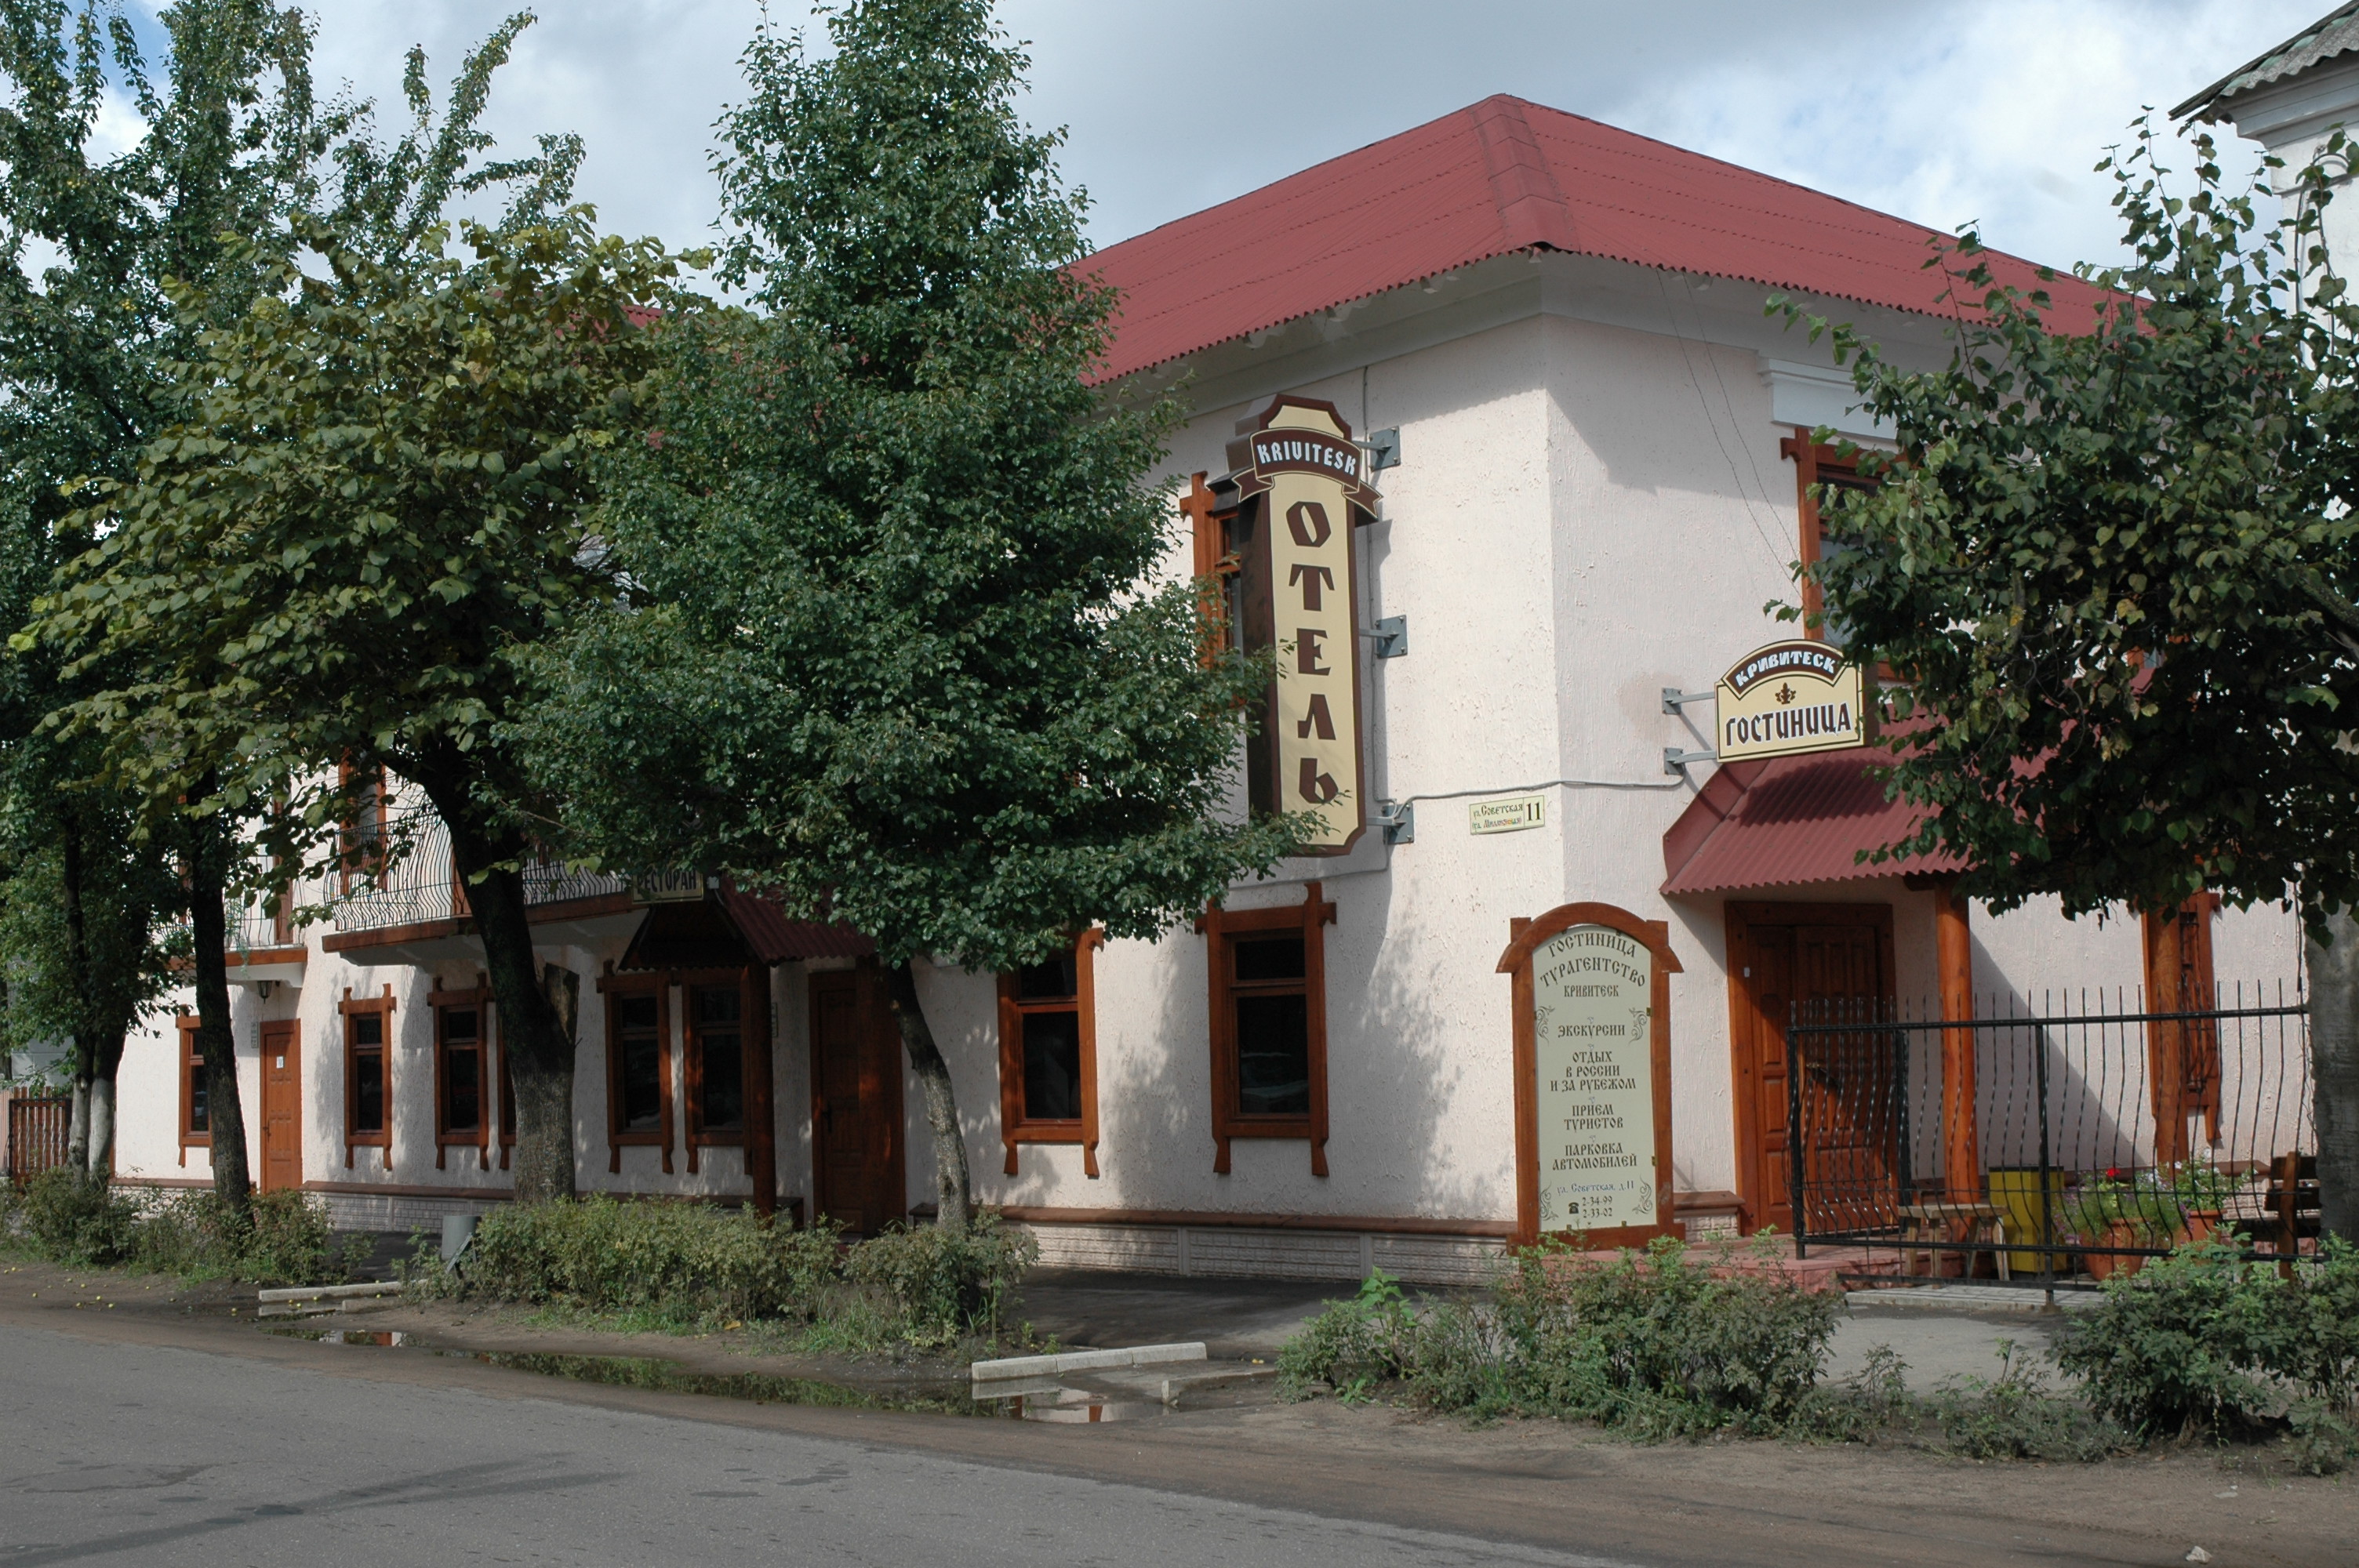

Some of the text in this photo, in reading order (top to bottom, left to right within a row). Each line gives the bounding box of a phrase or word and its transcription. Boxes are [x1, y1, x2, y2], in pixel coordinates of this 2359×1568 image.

[1285, 501, 1339, 804] ОТЕЛЬ
[1736, 651, 1837, 687] КРИВИТЕСК
[1726, 702, 1852, 746] ГОСТИНИЦА
[1481, 804, 1523, 816] Советская
[1526, 801, 1541, 822] 11
[1548, 932, 1636, 958] ГОСТИНИЦА
[1540, 957, 1645, 987] ТУРАГЕНТСТВО
[1564, 985, 1619, 997] КРИВИТЕСК
[1558, 1025, 1626, 1038] ЭКСКУРСИИ
[1572, 1051, 1612, 1064] ОТДЫХ
[1566, 1065, 1620, 1077] В РОССИИ
[1550, 1078, 1636, 1094] И ЗА РУБЕЖОМ
[1572, 1104, 1614, 1116] ПРИЕМ
[1564, 1117, 1623, 1133] ТУРИСТОВ
[1565, 1142, 1623, 1156] ПАРКОВКА
[1552, 1153, 1637, 1171] АВТОМОБИЛЕЙ
[1582, 1196, 1612, 1207] 2-34-99
[1583, 1207, 1612, 1218] 2-33-02
